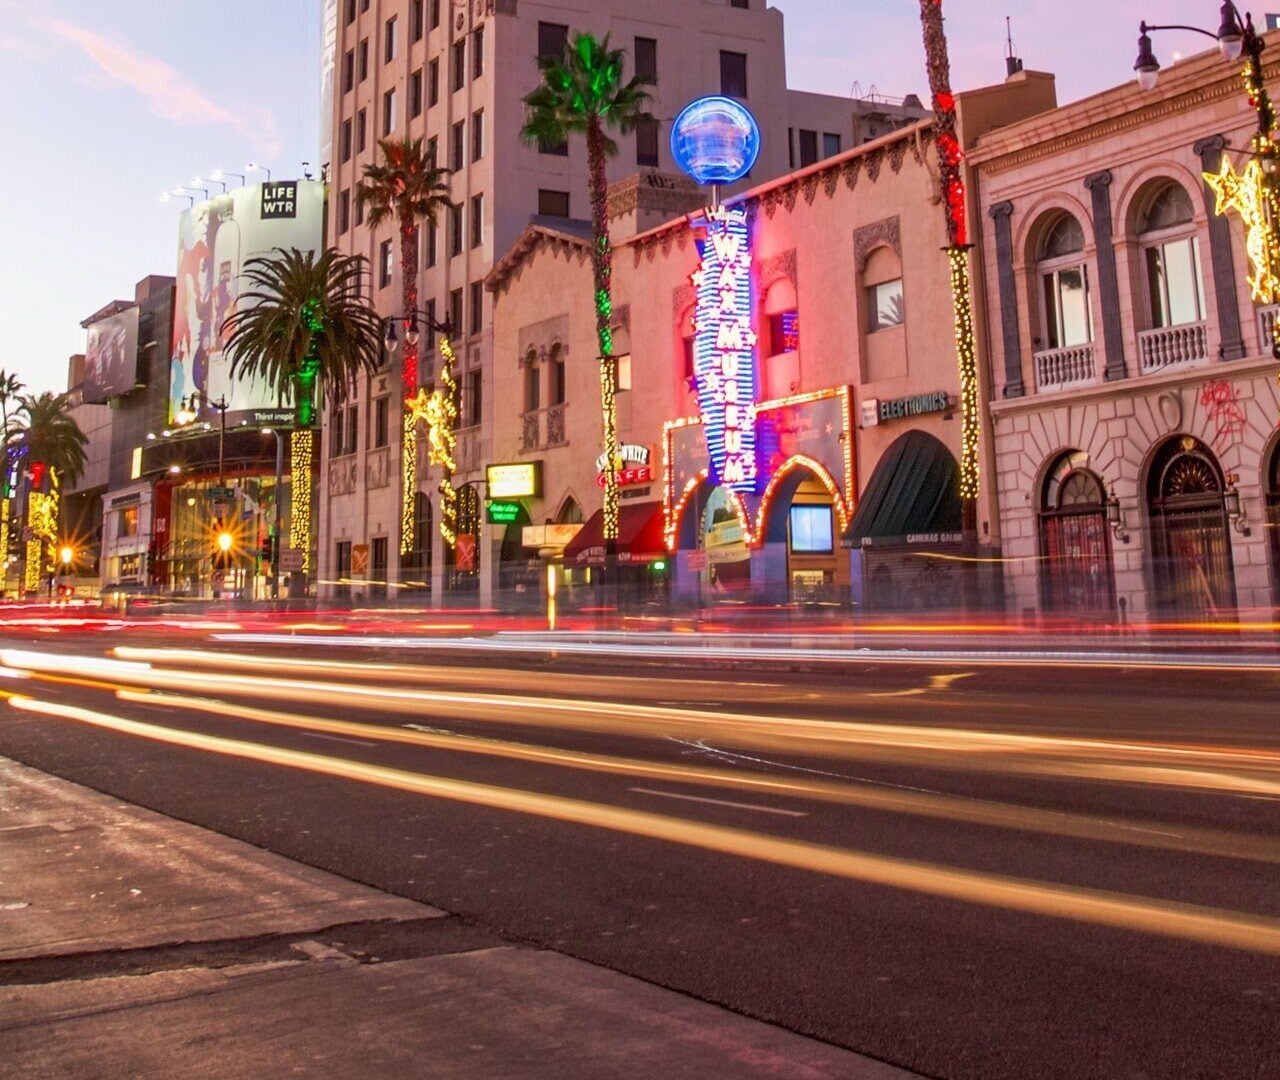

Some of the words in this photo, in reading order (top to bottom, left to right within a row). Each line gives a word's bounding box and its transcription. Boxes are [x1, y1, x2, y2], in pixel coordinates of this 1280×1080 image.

[264, 187, 295, 200] LIFE
[263, 201, 294, 213] WTR
[712, 233, 741, 313] WAX
[717, 322, 745, 481] MUSEUM
[880, 392, 947, 420] ELECTRONICS
[254, 412, 274, 421] Thirst
[275, 412, 295, 422] inspir
[906, 533, 939, 543] CAMERAS
[940, 533, 963, 543] GALOR
